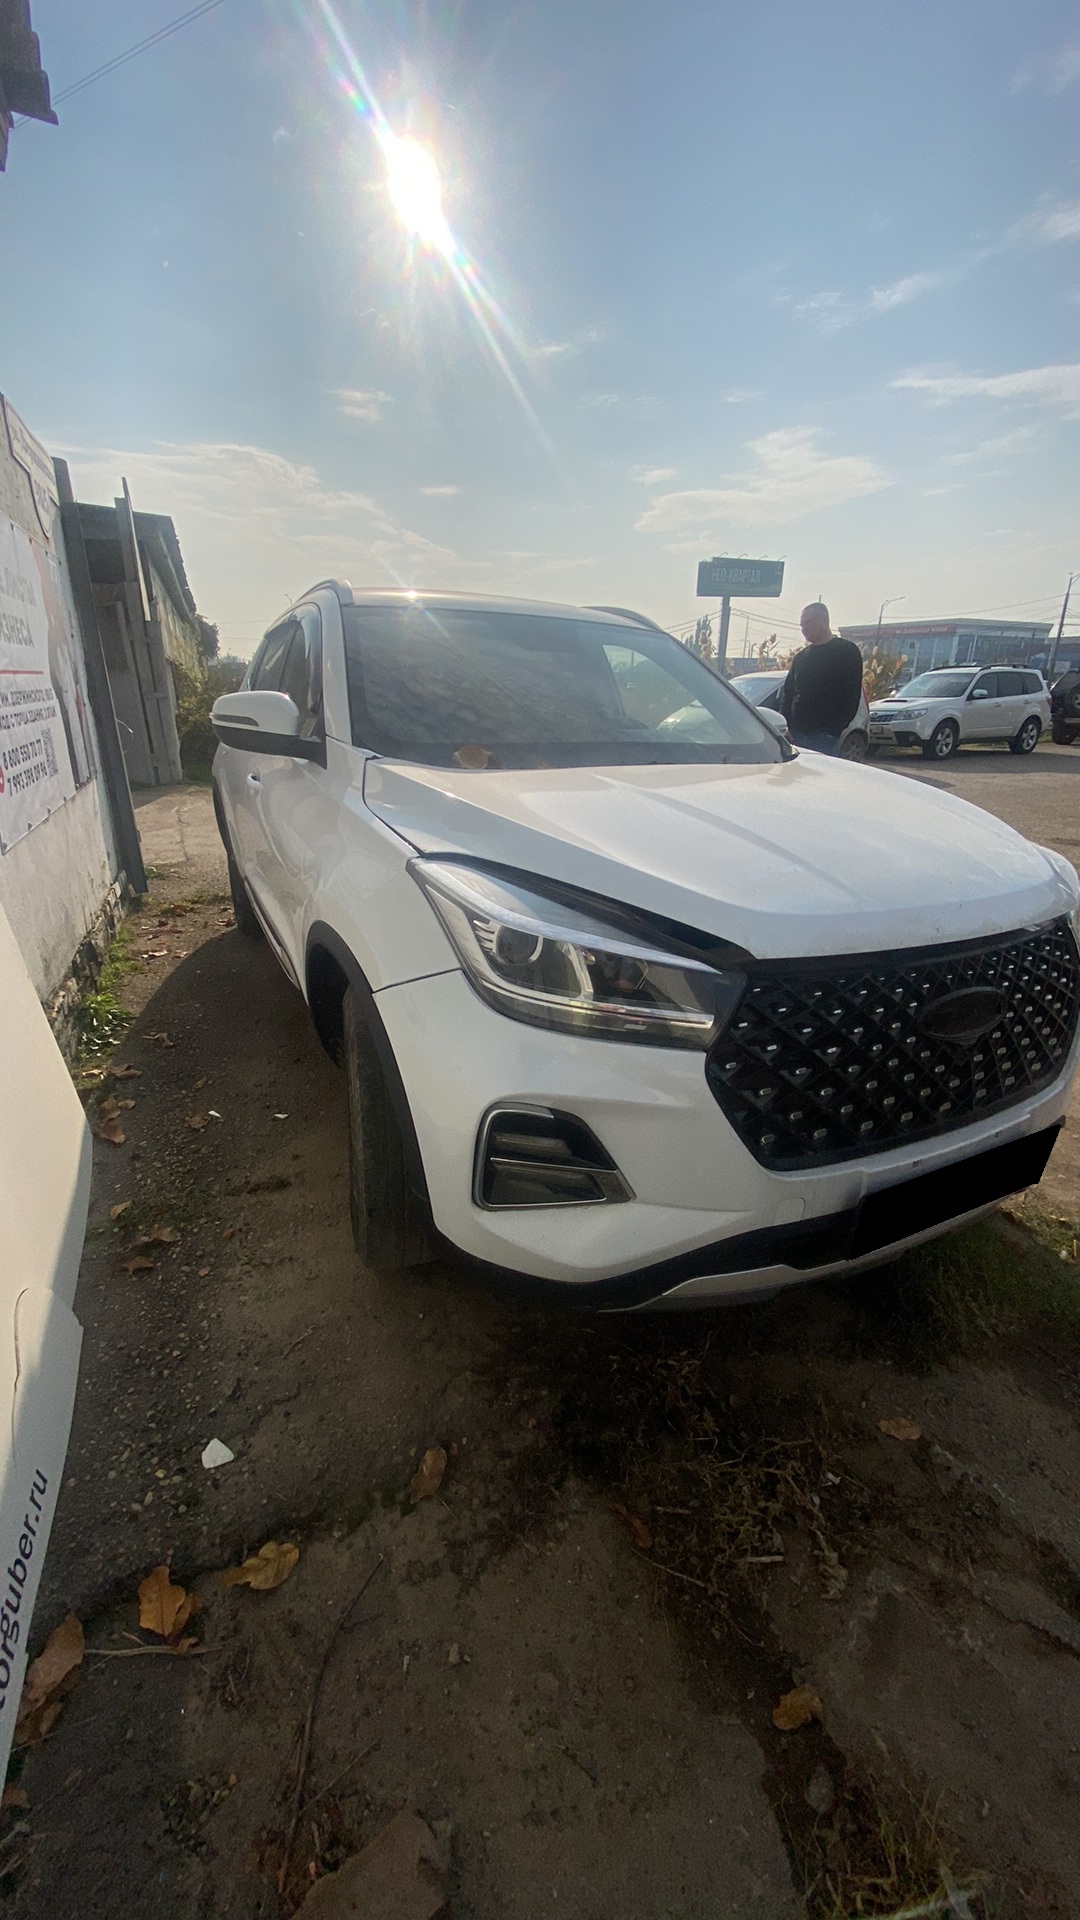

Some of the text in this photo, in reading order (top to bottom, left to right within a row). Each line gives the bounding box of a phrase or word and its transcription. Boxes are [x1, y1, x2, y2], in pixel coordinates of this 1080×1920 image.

[8, 748, 21, 768] 800
[20, 744, 31, 763] 550
[36, 739, 43, 756] 77
[12, 772, 25, 794] 993
[0, 1469, 48, 1710] orguber.ru
